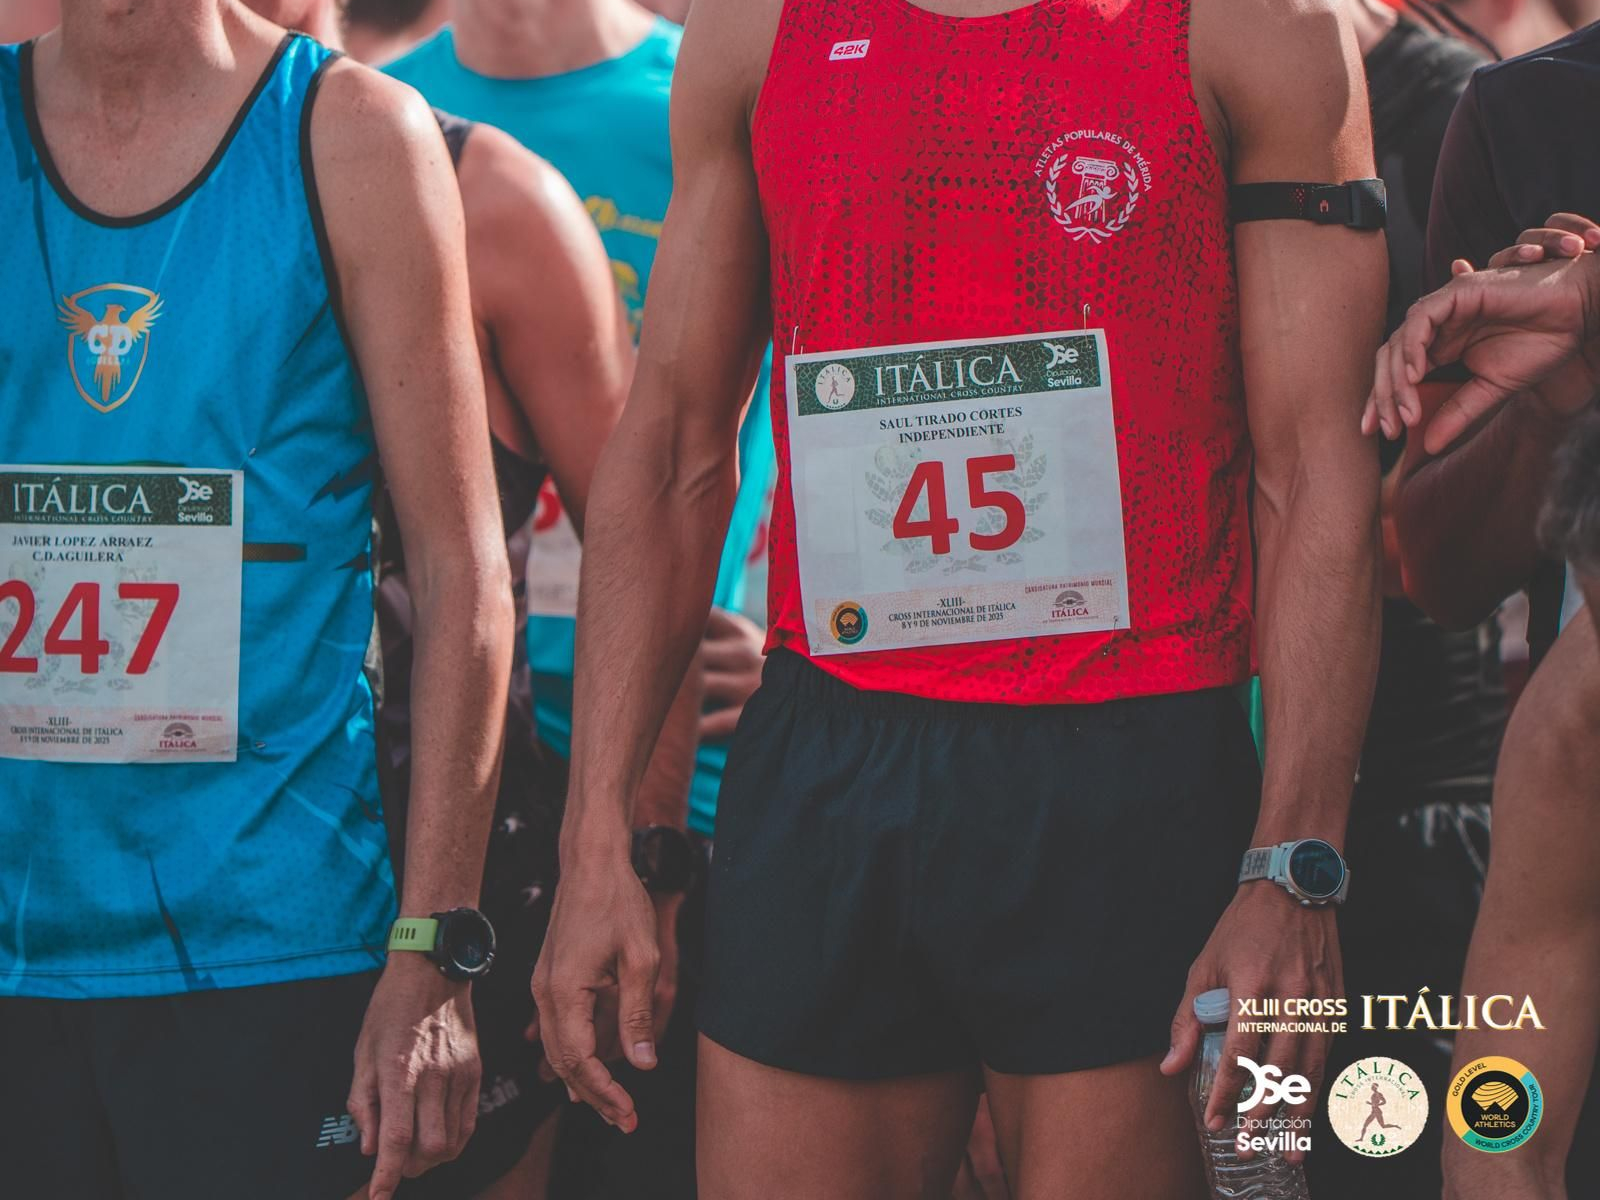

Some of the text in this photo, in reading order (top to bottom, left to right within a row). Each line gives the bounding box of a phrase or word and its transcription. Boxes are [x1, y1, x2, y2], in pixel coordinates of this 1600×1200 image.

[833, 43, 866, 56] 42K
[1033, 129, 1152, 192] ATLETAS POPULARES DE MÉRIDA
[88, 324, 132, 355] CD
[875, 354, 1023, 397] ITÁLICA
[1047, 375, 1082, 387] Sevilla
[876, 384, 1024, 405] INTERNATIONAL CROSS COUNTRY
[880, 406, 1023, 430] SAUL TIRADO CORTES
[899, 423, 1005, 443] INDEPENDIENTE
[13, 476, 153, 514] ITÁLICA
[893, 454, 1026, 555] 45
[178, 512, 213, 523] Sevilla
[12, 535, 153, 548] JAVIER LOPEZ ARRAEZ
[32, 551, 124, 562] C.D.AGUILERA
[889, 611, 912, 622] CROSS
[913, 605, 975, 620] INTERNACIONAL
[976, 604, 986, 614] DE
[919, 619, 930, 628] DE
[931, 614, 975, 627] NOVIEMBRE
[976, 613, 986, 622] DE
[988, 611, 1004, 621] 2025
[1051, 607, 1089, 618] ITÁLICA
[0, 579, 180, 675] 247
[82, 727, 92, 736] DE
